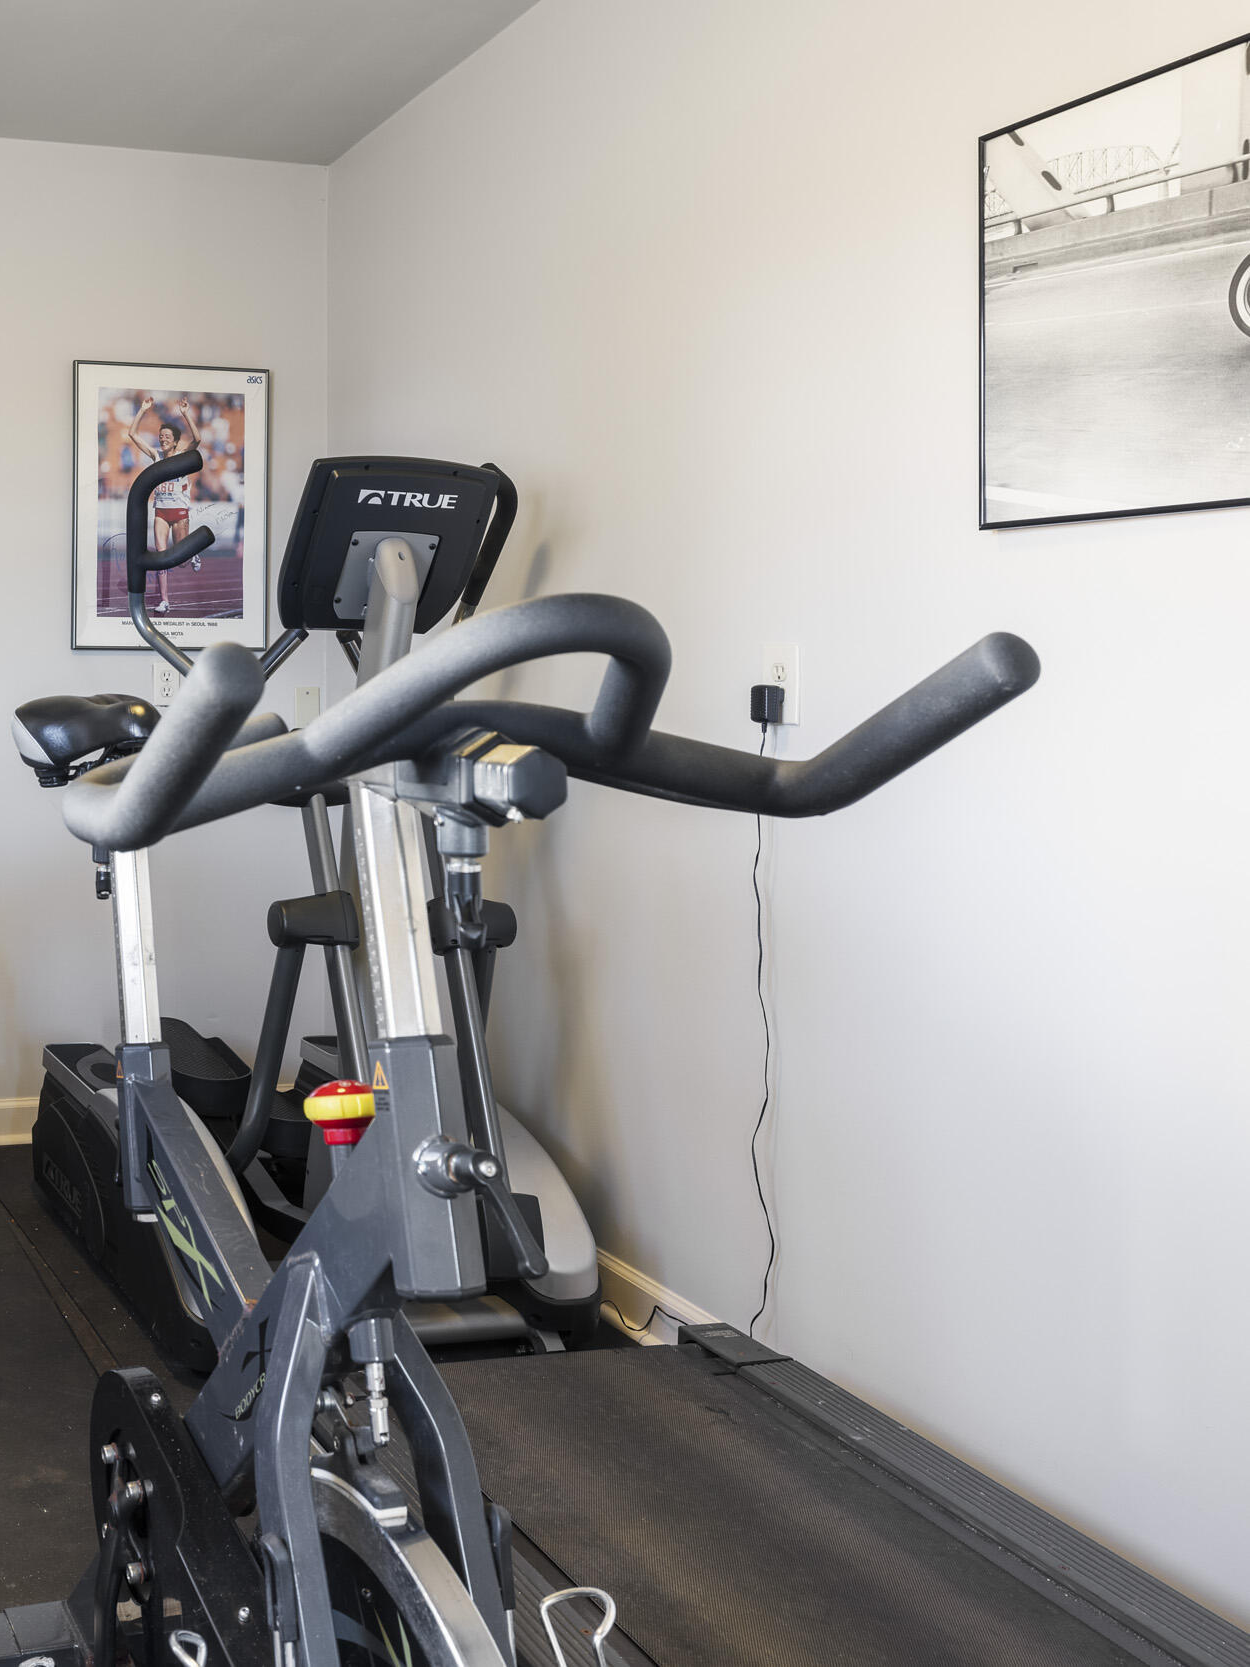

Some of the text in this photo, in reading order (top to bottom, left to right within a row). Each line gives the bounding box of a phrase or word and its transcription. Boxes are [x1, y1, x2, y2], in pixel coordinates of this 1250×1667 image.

[246, 375, 263, 385] asics
[387, 490, 459, 510] TRUE
[235, 1372, 267, 1420] BODYCR
